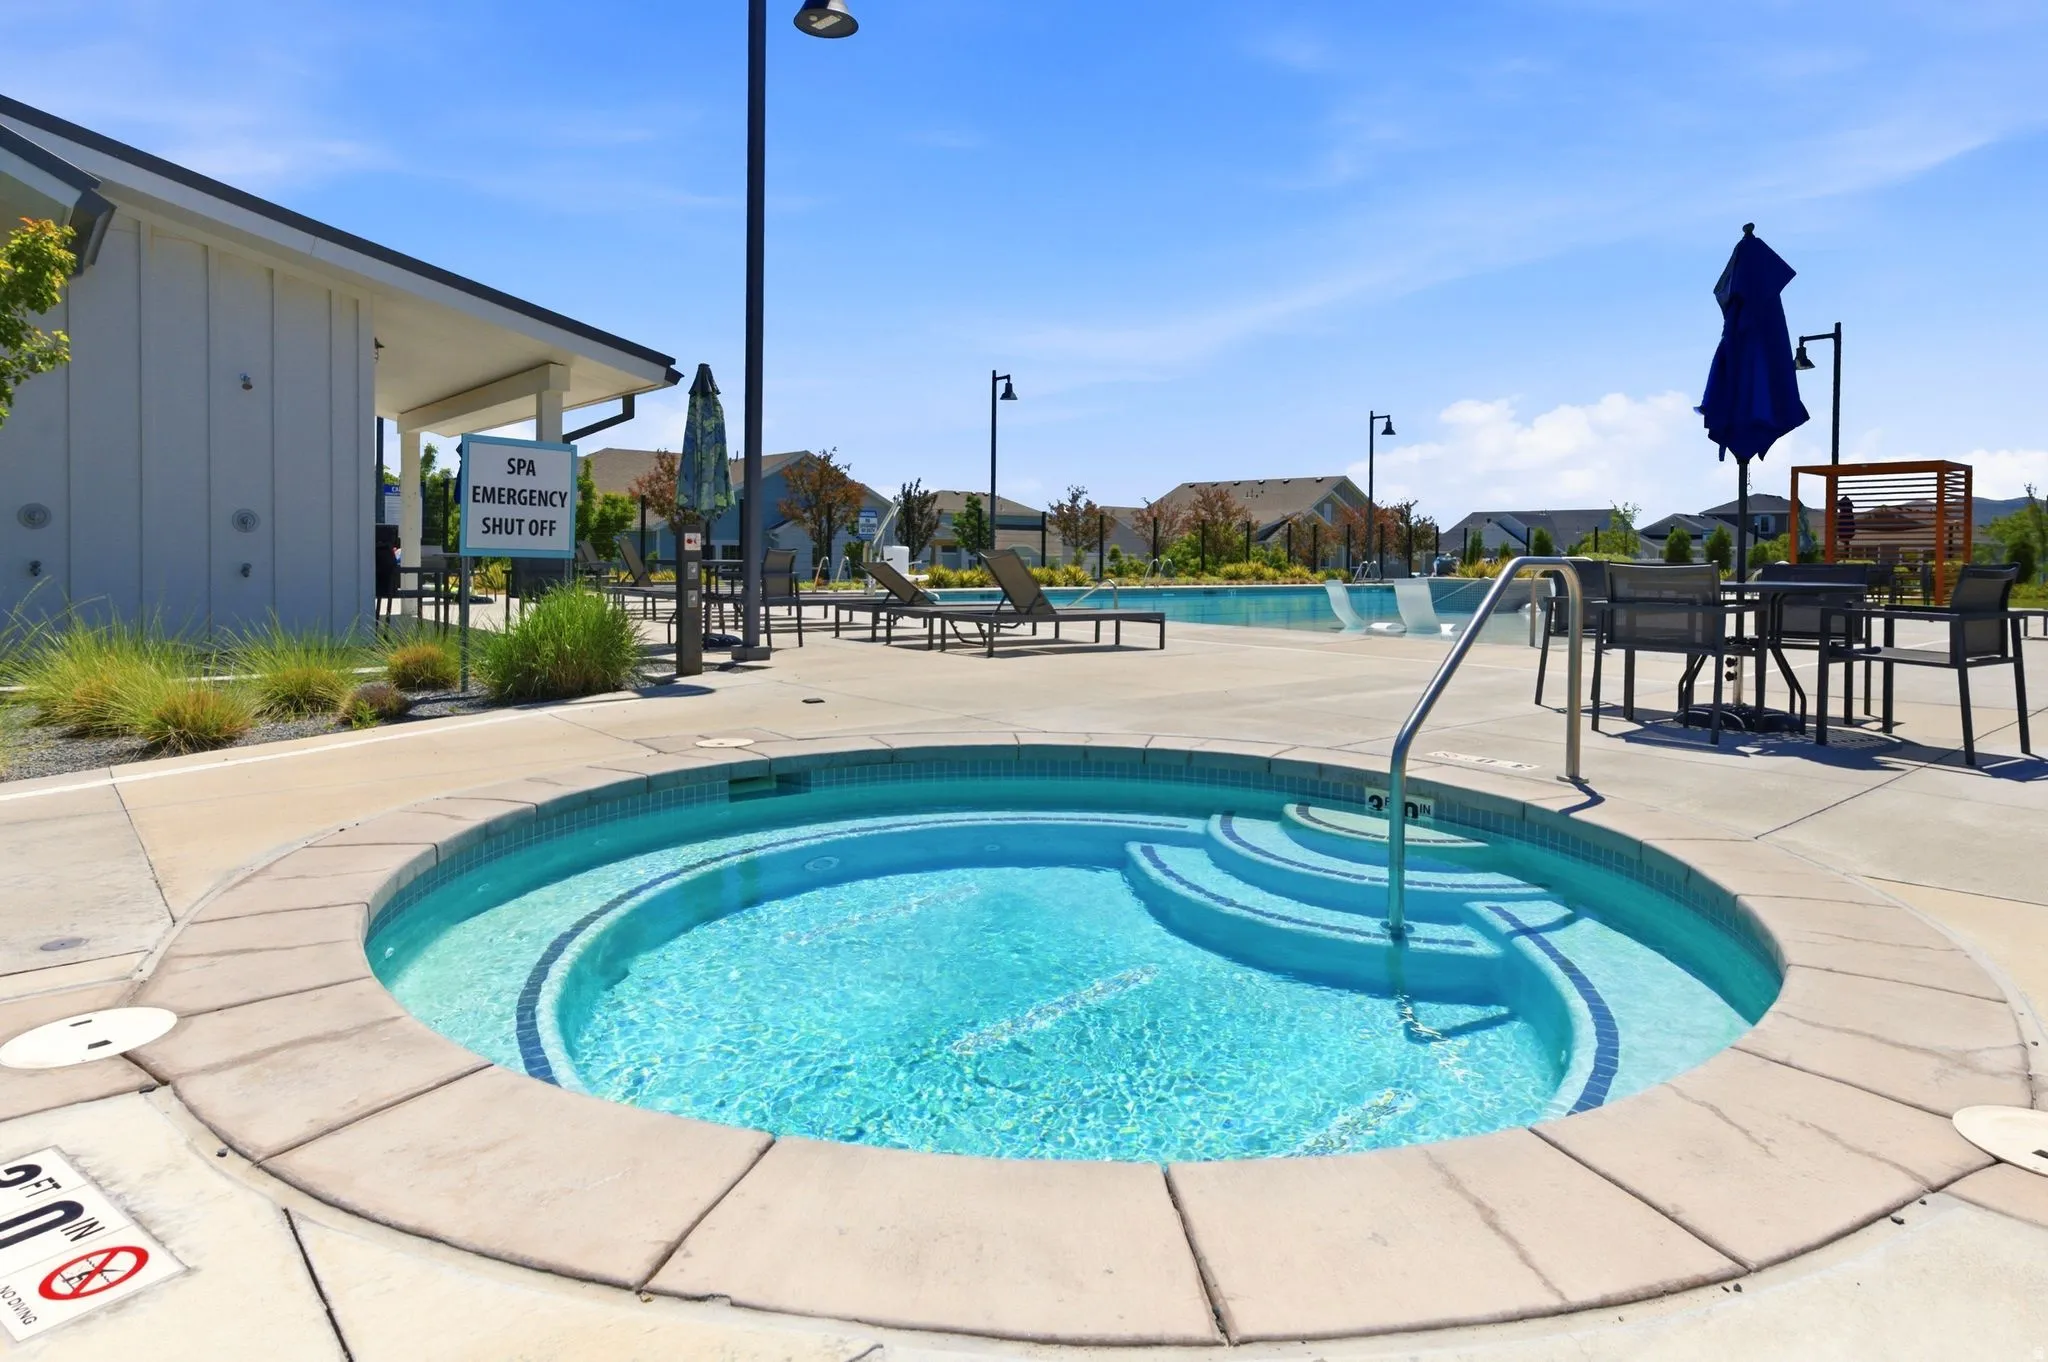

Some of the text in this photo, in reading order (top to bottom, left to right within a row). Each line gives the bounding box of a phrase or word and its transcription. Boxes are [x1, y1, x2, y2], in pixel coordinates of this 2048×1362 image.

[507, 458, 536, 476] SPA
[472, 486, 568, 508] EMERGENCY
[481, 517, 557, 537] SHUT OFF
[1420, 803, 1432, 815] IN
[60, 1216, 105, 1243] IN
[7, 1297, 38, 1326] DIVING
